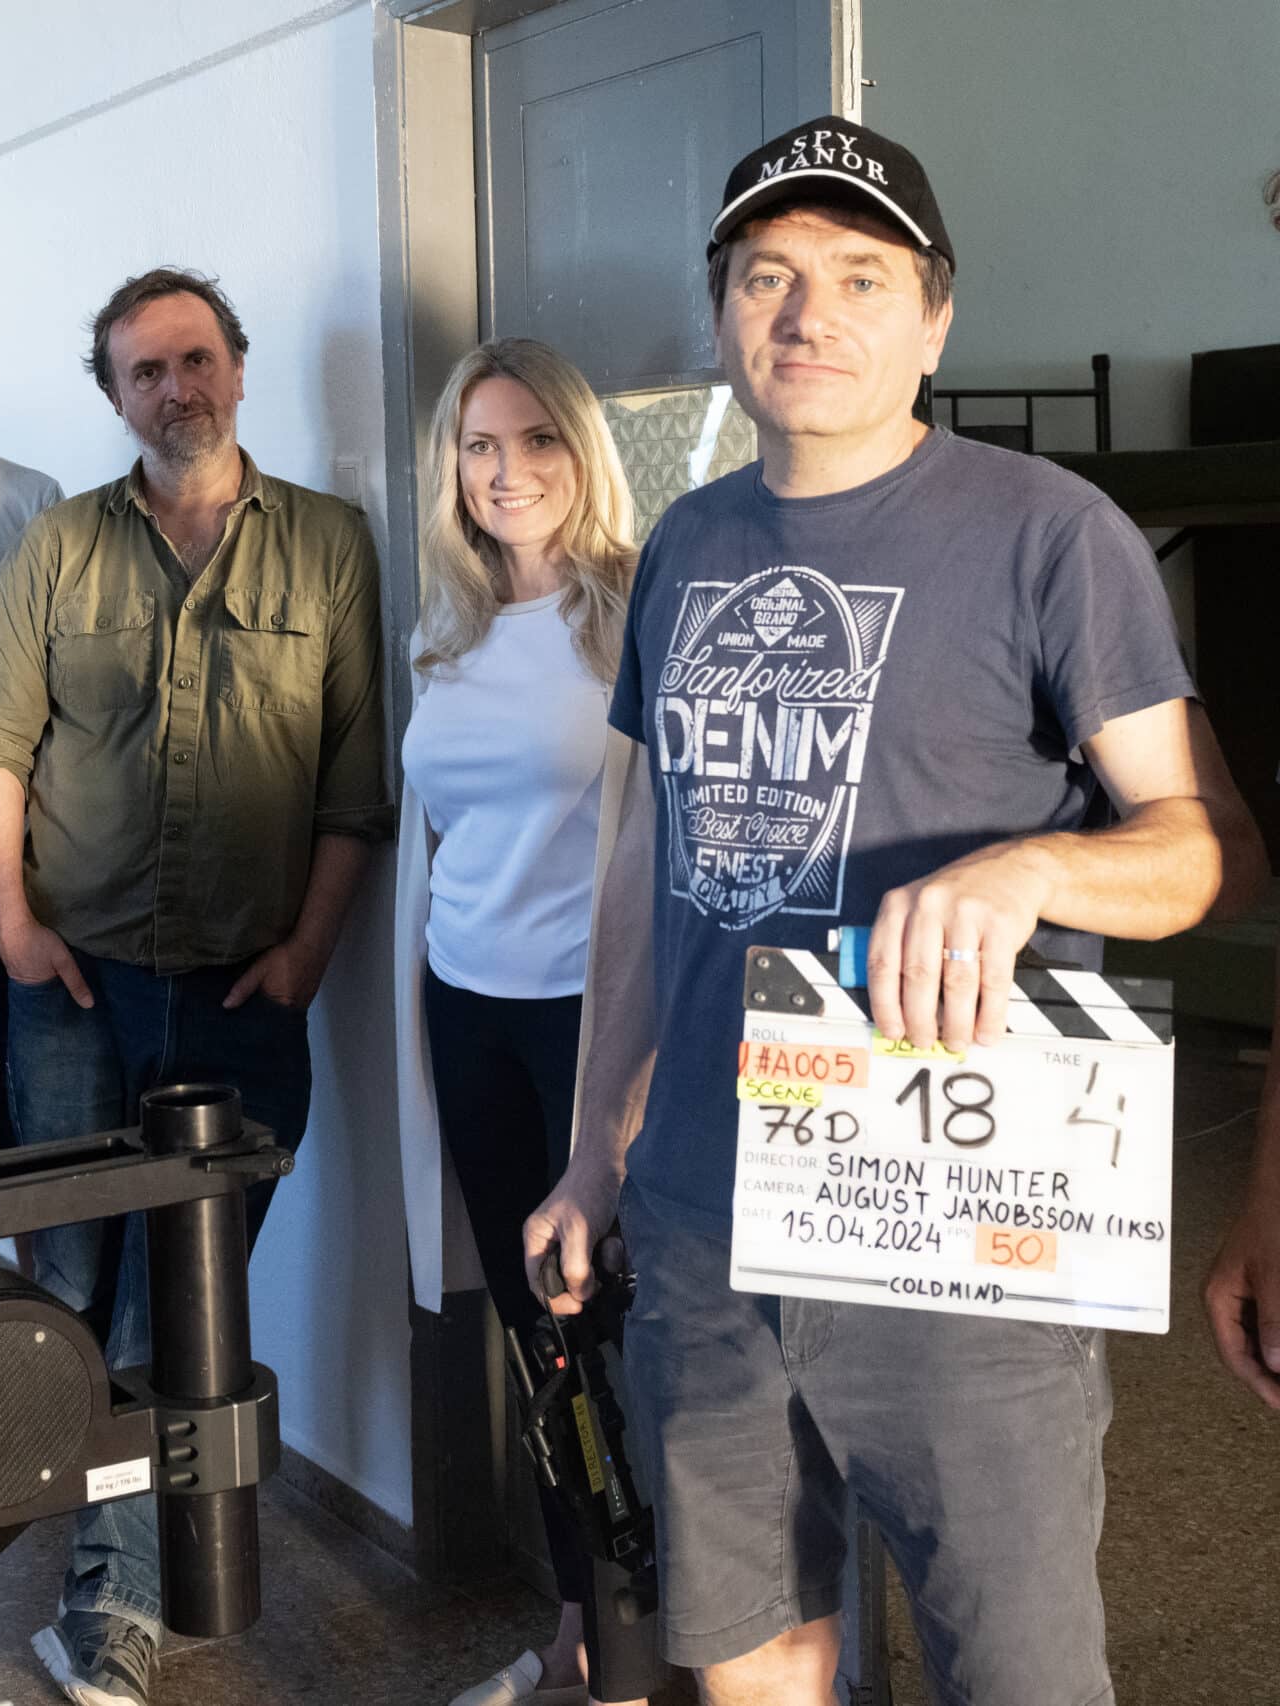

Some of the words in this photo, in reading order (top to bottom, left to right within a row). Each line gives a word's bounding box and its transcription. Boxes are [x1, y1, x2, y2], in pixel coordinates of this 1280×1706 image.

[791, 130, 858, 154] SPY
[757, 148, 888, 185] MANOR
[750, 596, 807, 612] ORIGINAL
[753, 611, 798, 625] BRAND
[717, 632, 755, 647] UNION
[787, 635, 828, 648] MADE
[660, 645, 886, 711] Sanforized
[655, 697, 871, 783] DENIM
[680, 784, 748, 810] LIMITED
[756, 785, 826, 820] EDITION
[688, 807, 742, 839] Best
[746, 812, 809, 847] Choice
[696, 847, 784, 884] FINEST
[751, 1028, 788, 1042] ROLL
[754, 1045, 855, 1084] #A005
[1044, 1051, 1081, 1066] TAKE
[745, 1078, 816, 1103] SCENE
[896, 1067, 996, 1149] 18
[827, 1152, 924, 1187] SIMON
[947, 1164, 1070, 1201] HUNTER
[815, 1182, 930, 1216] AUGUST
[943, 1195, 1094, 1234] JAKOBSSON
[782, 1209, 942, 1254] 15.04.2024
[991, 1232, 1044, 1265] 50
